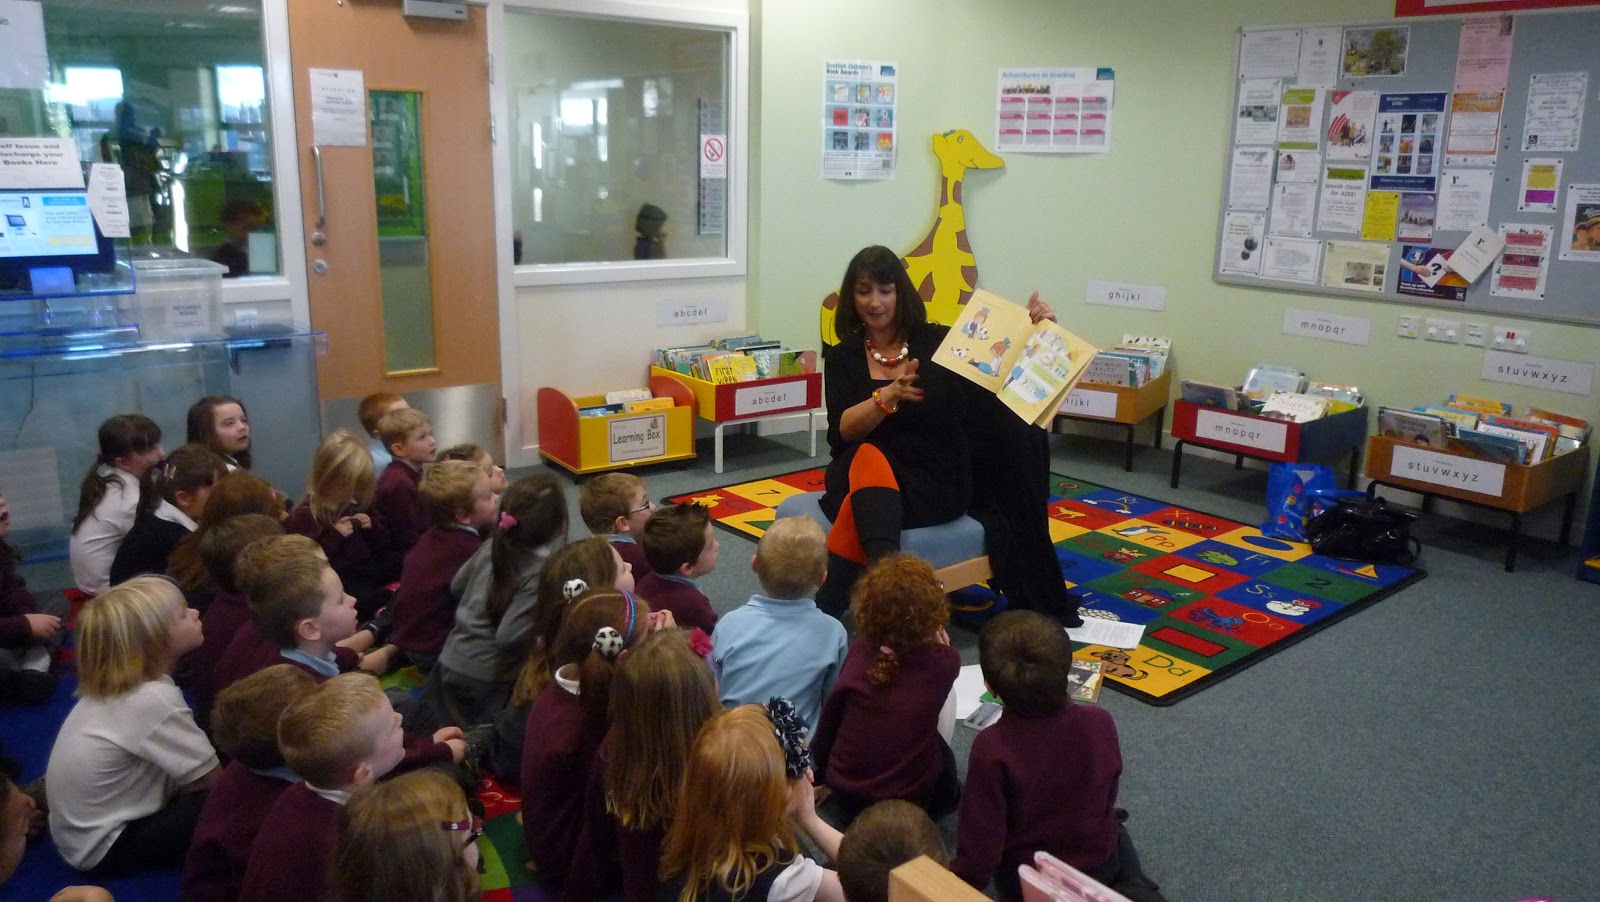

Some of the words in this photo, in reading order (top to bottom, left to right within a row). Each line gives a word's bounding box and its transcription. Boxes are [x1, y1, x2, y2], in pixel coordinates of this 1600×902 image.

[1050, 72, 1076, 80] reading
[674, 308, 708, 318] abcdef
[1301, 321, 1346, 335] mnopqr
[1498, 366, 1568, 384] stuvwxyz
[752, 393, 787, 406] abcdef
[613, 431, 645, 444] Learning
[647, 428, 661, 440] Box
[1215, 424, 1262, 440] mnopqr
[1408, 462, 1479, 482] stuvwxyz
[1144, 534, 1175, 548] Pp
[1245, 584, 1278, 598] Ss
[1242, 612, 1284, 630] Oo
[1142, 654, 1193, 677] Dd
